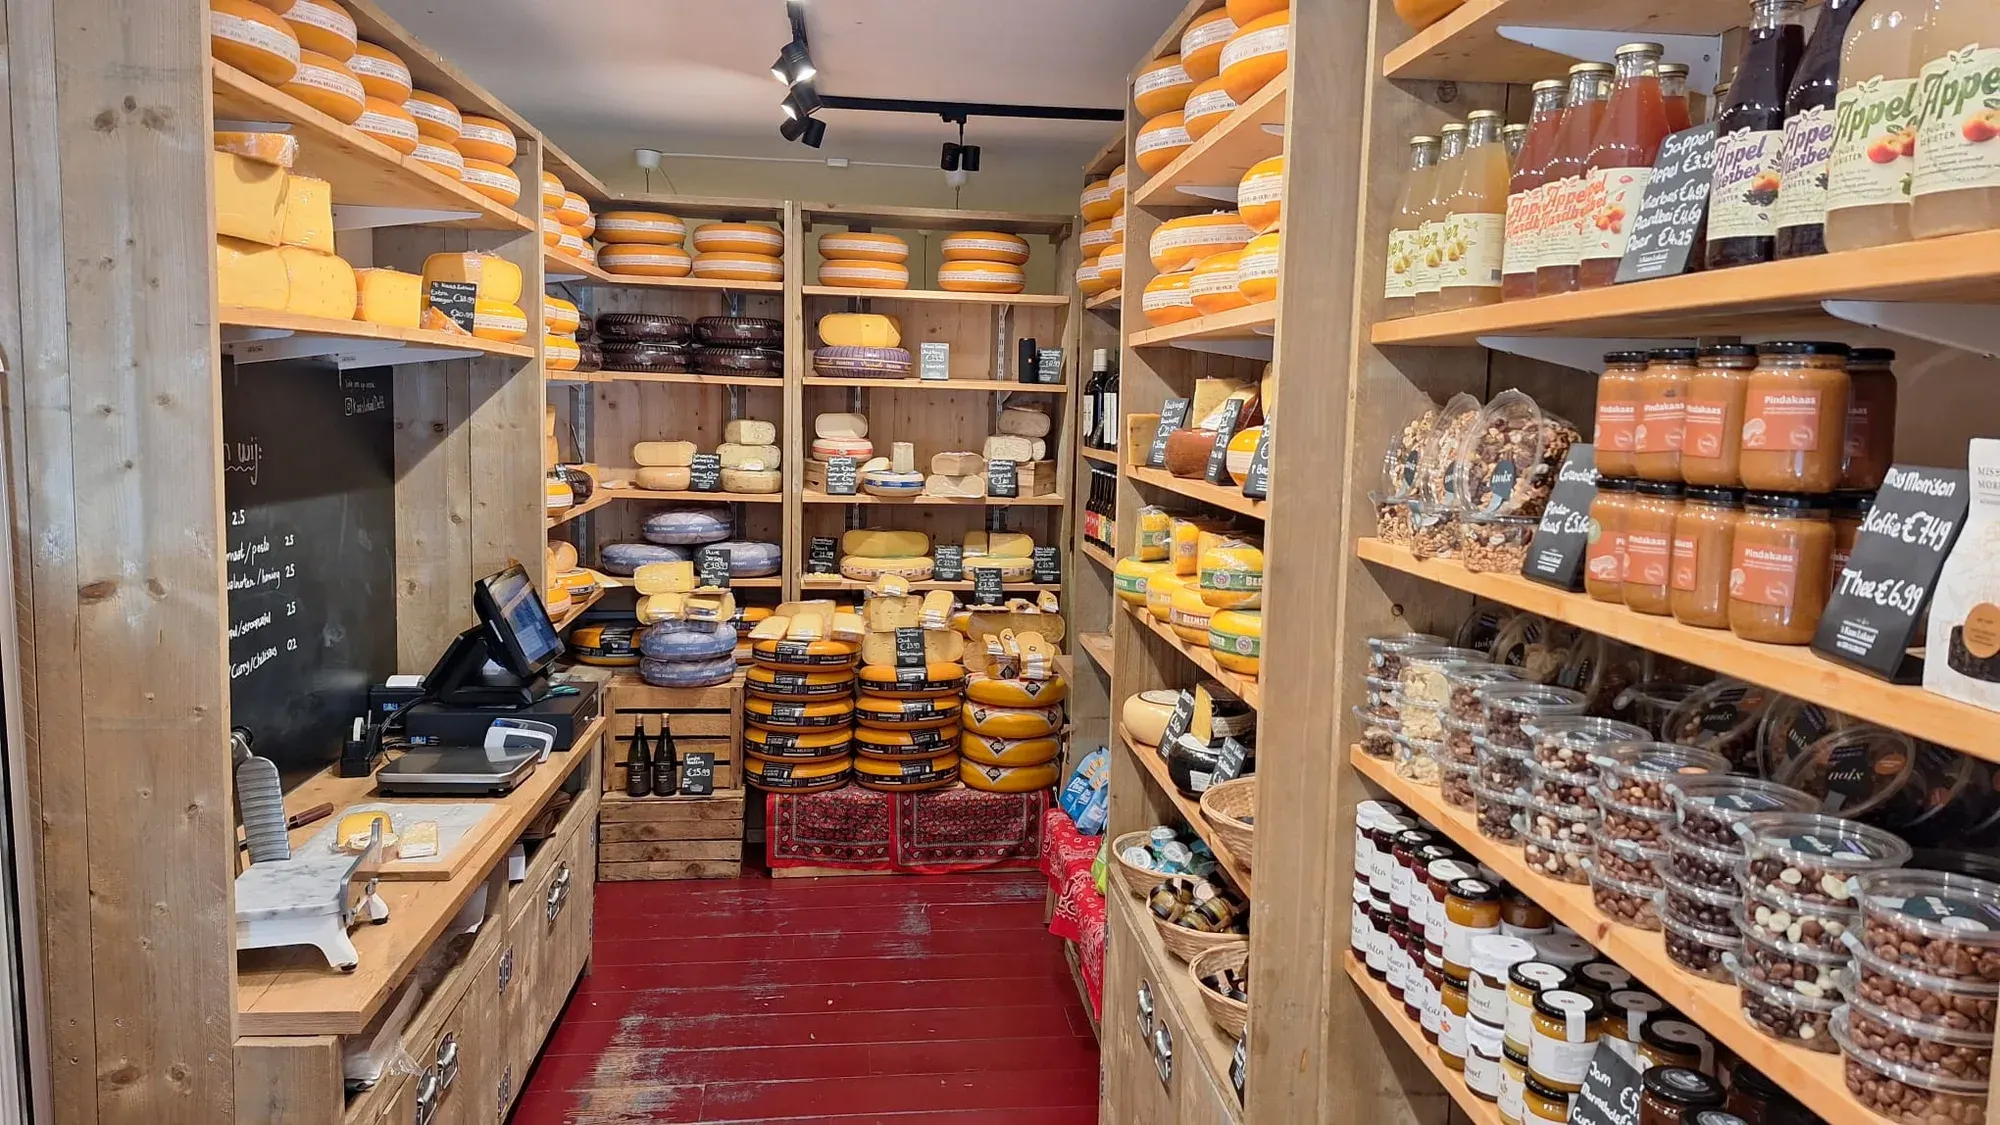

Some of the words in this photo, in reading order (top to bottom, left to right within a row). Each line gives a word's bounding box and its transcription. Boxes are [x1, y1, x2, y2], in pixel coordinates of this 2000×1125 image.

[1916, 67, 2000, 132] Appe
[1832, 82, 1919, 150] Appel
[1663, 130, 1714, 157] Sappen
[1780, 120, 1834, 160] Appe
[1650, 161, 1678, 184] Appel
[1633, 207, 1674, 232] Aardbei
[1658, 226, 1693, 247] €4.25
[1764, 394, 1816, 405] Pindakaas
[238, 436, 262, 486] wij:
[232, 509, 245, 526] 2.5
[1863, 504, 1901, 538] Koffie
[1902, 511, 1953, 552] €7.49
[1744, 548, 1793, 562] Pindakaas
[1840, 568, 1874, 599] Thee
[1874, 579, 1924, 616] €6.99
[1182, 614, 1211, 628] BEEMST
[1590, 1061, 1612, 1088] Jam
